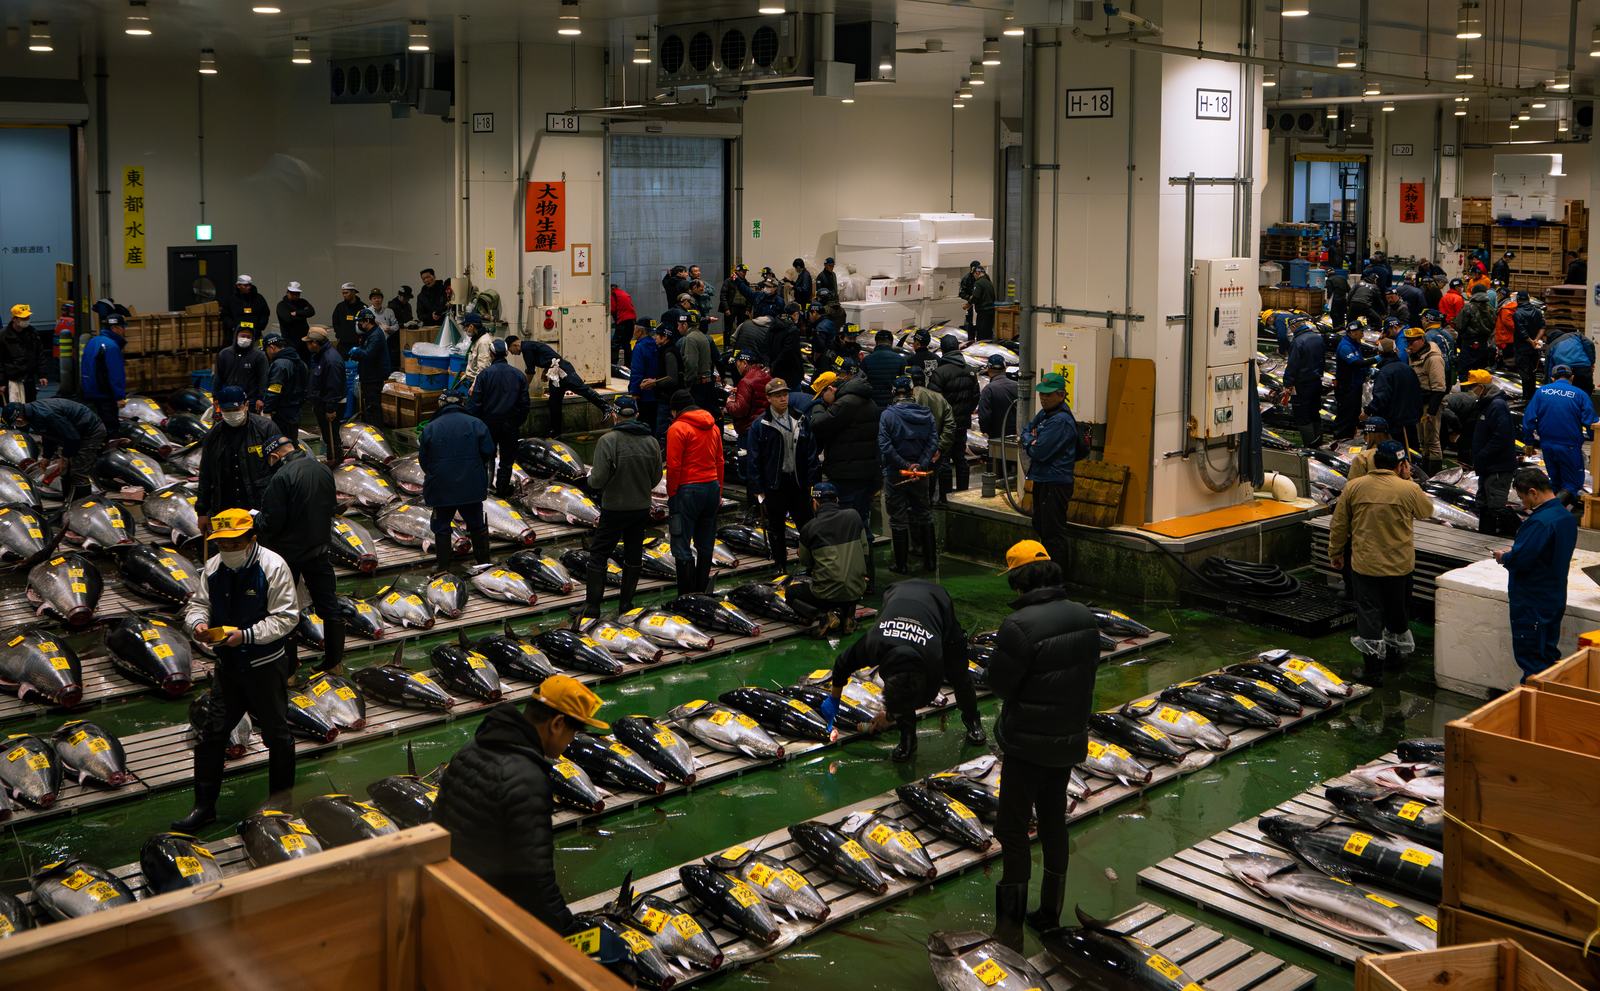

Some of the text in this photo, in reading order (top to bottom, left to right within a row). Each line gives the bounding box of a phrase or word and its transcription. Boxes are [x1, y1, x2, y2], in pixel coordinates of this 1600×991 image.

[1071, 94, 1109, 112] H-18
[1200, 96, 1228, 113] H-18
[476, 117, 491, 129] I-18
[552, 117, 574, 129] I-18
[1405, 184, 1419, 222] 大物生鮮
[124, 169, 144, 264] 東都水産
[535, 183, 559, 250] 大物生鮮
[752, 219, 761, 239] 東市
[1541, 388, 1576, 399] HOKUEI
[879, 620, 934, 639] ARMOUR
[883, 628, 927, 646] UNDER
[185, 860, 199, 868] 90
[678, 918, 697, 932] 123
[628, 934, 648, 948] 124
